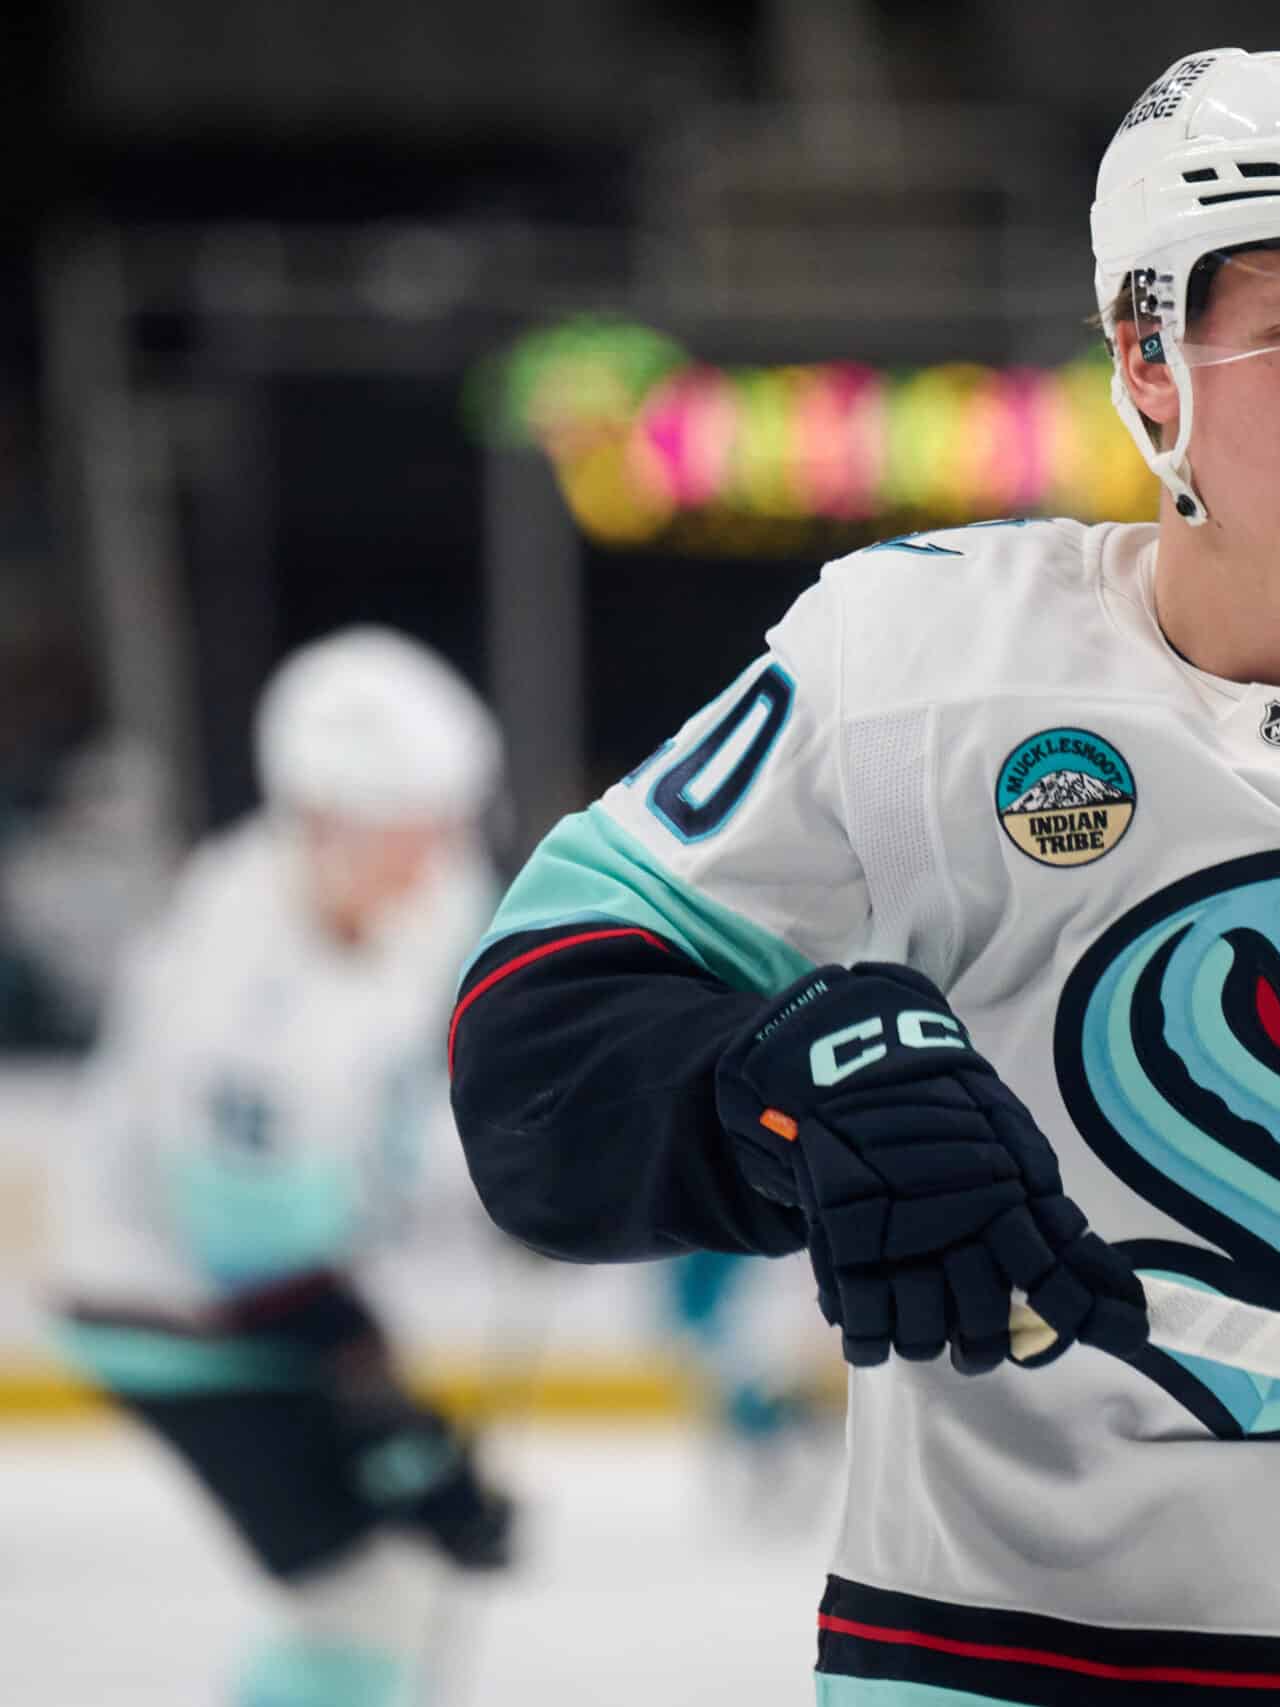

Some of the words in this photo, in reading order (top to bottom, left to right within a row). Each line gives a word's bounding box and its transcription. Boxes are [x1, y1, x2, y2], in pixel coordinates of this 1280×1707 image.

[1006, 737, 1124, 794] MUCKLESHOOT
[1029, 810, 1108, 836] INDIAN
[1035, 830, 1105, 854] TRIBE
